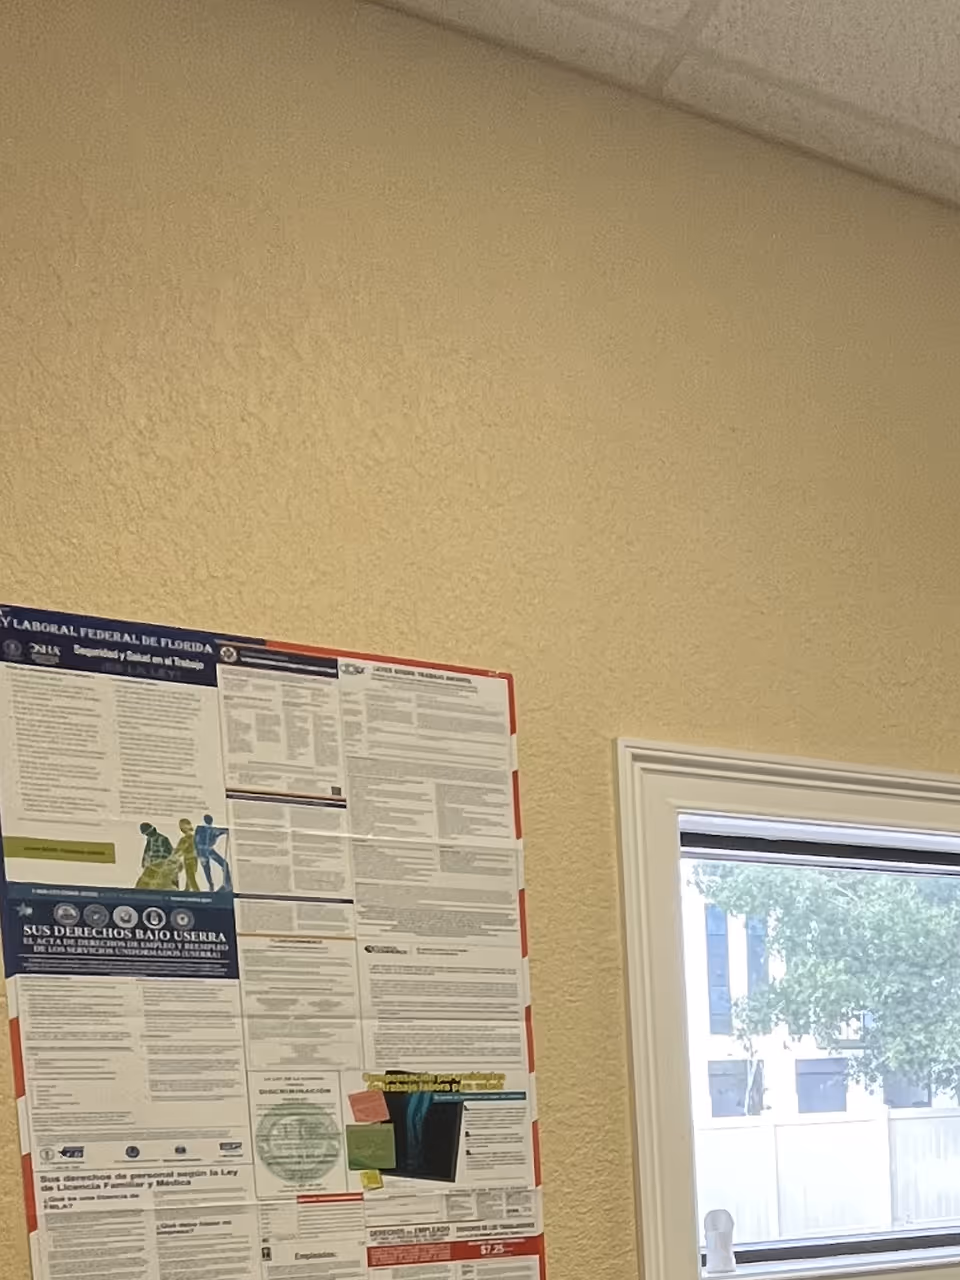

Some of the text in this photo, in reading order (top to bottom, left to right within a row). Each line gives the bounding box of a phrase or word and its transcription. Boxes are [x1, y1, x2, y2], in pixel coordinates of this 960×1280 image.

[13, 619, 78, 637] LABORAL
[80, 627, 139, 645] FEDERAL
[142, 634, 158, 646] DE
[160, 637, 213, 653] FLORIDA
[23, 925, 226, 942] SUS DERECHOS BAJO USERRA
[23, 937, 34, 945] EL
[36, 937, 61, 945] ACTA
[63, 938, 76, 946] DE
[33, 945, 46, 953] DE
[40, 1175, 60, 1184] Sus
[63, 1173, 111, 1183] derechos
[130, 1171, 174, 1181] personal
[220, 1168, 239, 1177] Ley
[41, 1184, 54, 1192] de
[57, 1182, 101, 1192] Licencia
[480, 1244, 505, 1255] $7.25
